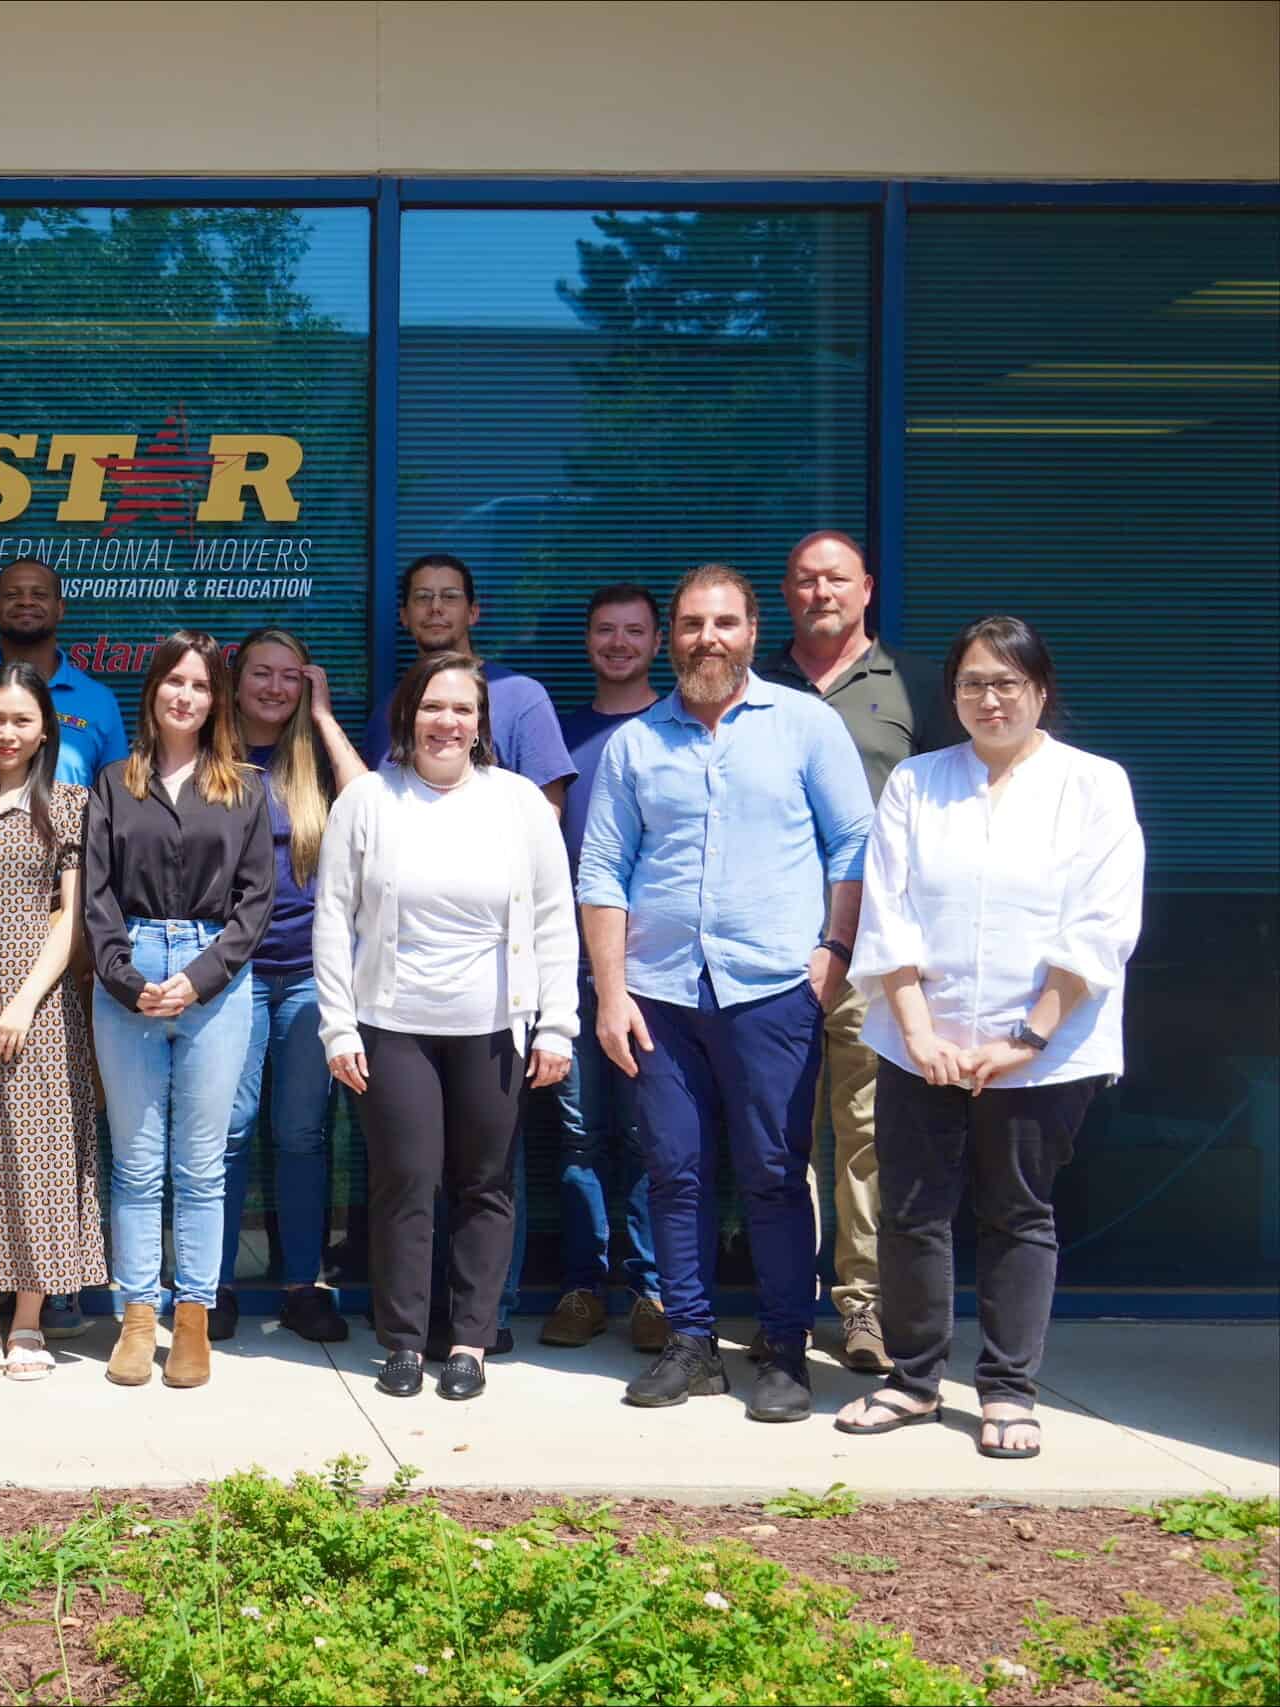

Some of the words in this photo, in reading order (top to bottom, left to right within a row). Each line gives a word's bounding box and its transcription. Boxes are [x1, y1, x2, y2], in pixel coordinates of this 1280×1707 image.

[192, 538, 312, 572] MOVERS
[61, 578, 179, 598] NSPORTATION
[184, 579, 197, 598] &
[204, 578, 312, 598] RELOCATION
